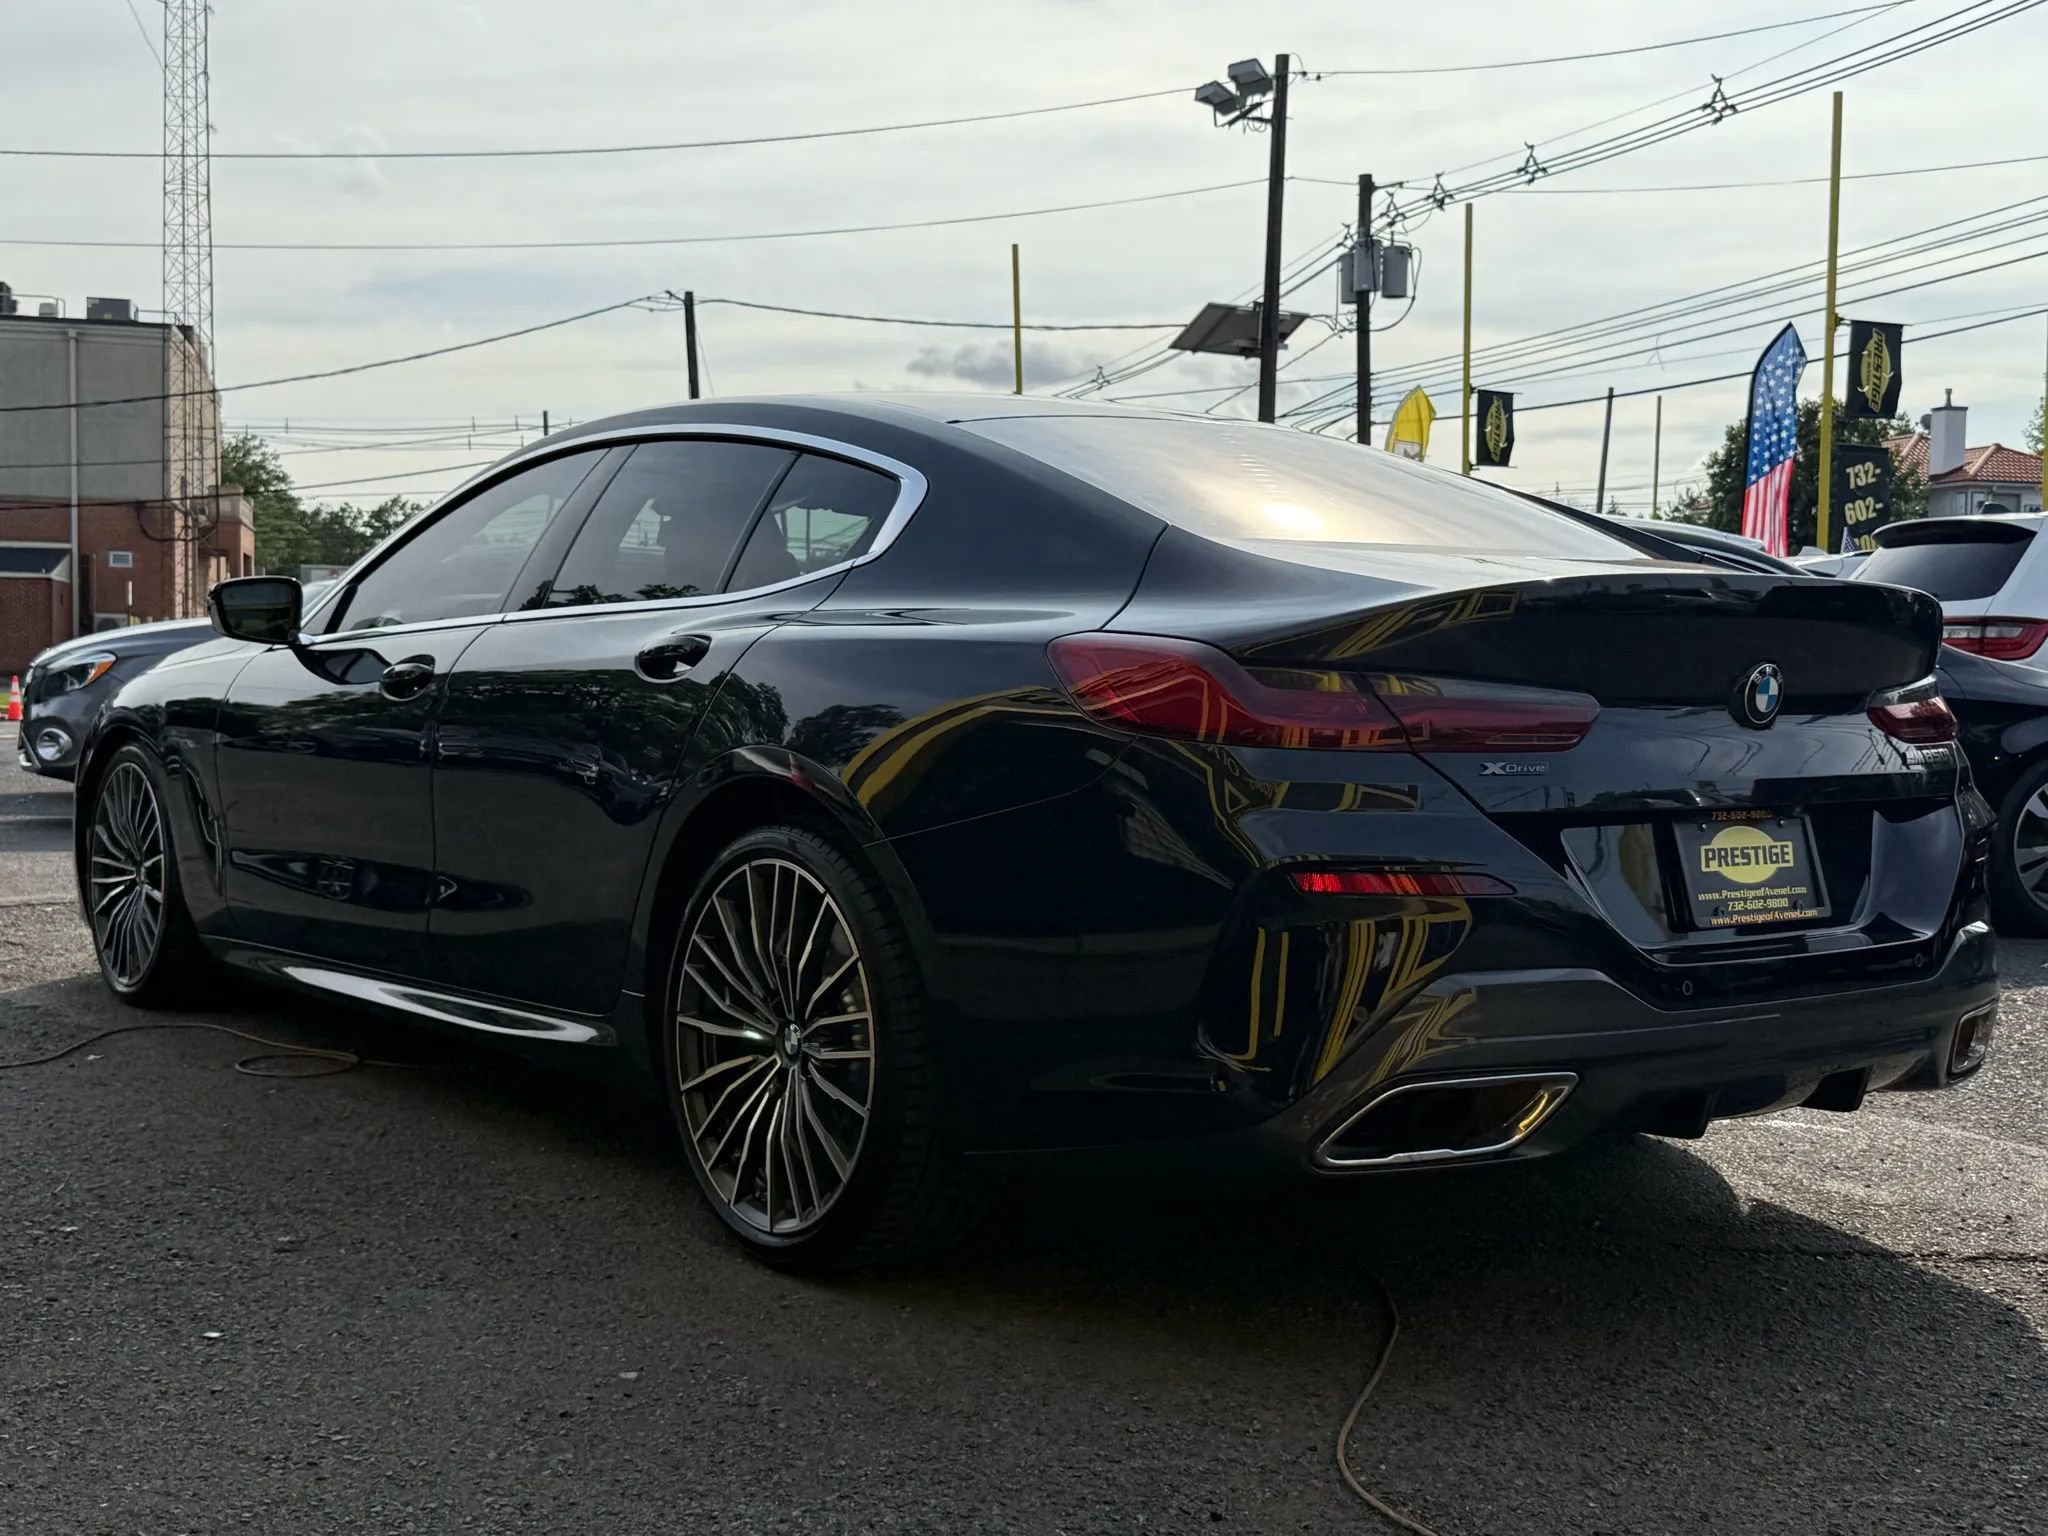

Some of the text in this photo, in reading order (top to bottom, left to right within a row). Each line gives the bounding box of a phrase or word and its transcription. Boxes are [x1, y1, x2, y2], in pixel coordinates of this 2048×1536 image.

[1869, 328, 1884, 411] PRESTIGE
[1845, 461, 1881, 490] 732-
[1844, 497, 1883, 525] 602-
[1704, 844, 1791, 868] PRESTIGE
[1698, 886, 1807, 900] www.PrestigeofAvenel.com
[1728, 898, 1789, 911] 732-602-9800
[1711, 910, 1818, 926] www.PrestigeofAvenel.com
